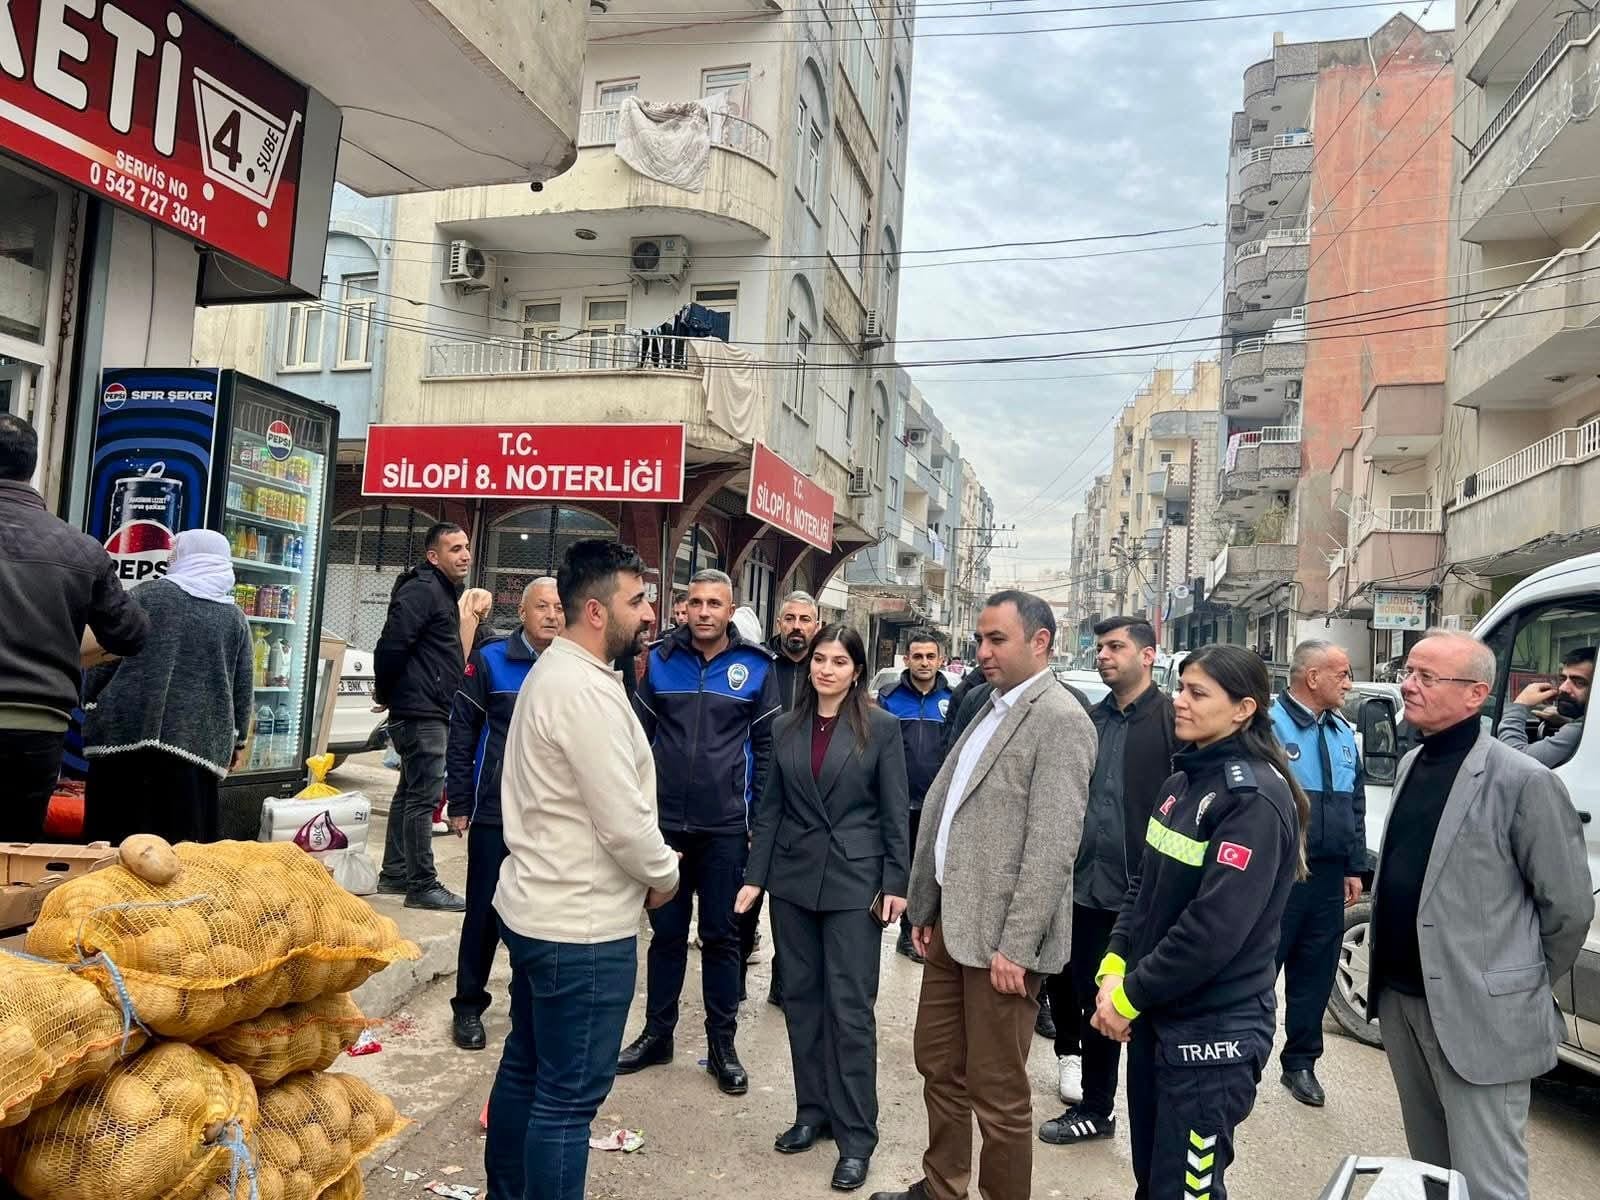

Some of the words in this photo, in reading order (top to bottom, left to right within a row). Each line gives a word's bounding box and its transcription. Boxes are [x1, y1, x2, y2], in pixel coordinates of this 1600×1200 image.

[256, 127, 279, 175] ŞUBE
[115, 150, 166, 190] SERVİS
[168, 180, 188, 201] NO
[90, 162, 101, 185] 0
[105, 168, 136, 202] 542
[140, 185, 169, 217] 727
[171, 201, 207, 236] 3031
[131, 390, 165, 400] SIFIR
[167, 390, 213, 403] ŞEKER
[268, 433, 291, 448] PEPSI
[498, 432, 539, 456] T.C.
[382, 458, 468, 489] SİLOPİ
[475, 464, 497, 490] 8.
[505, 459, 663, 493] NOTERLİĞİ
[793, 474, 805, 501] T.C.
[756, 481, 786, 520] SİLOPİ
[785, 501, 793, 525] 8.
[793, 506, 829, 544] NOTERLİĞİ
